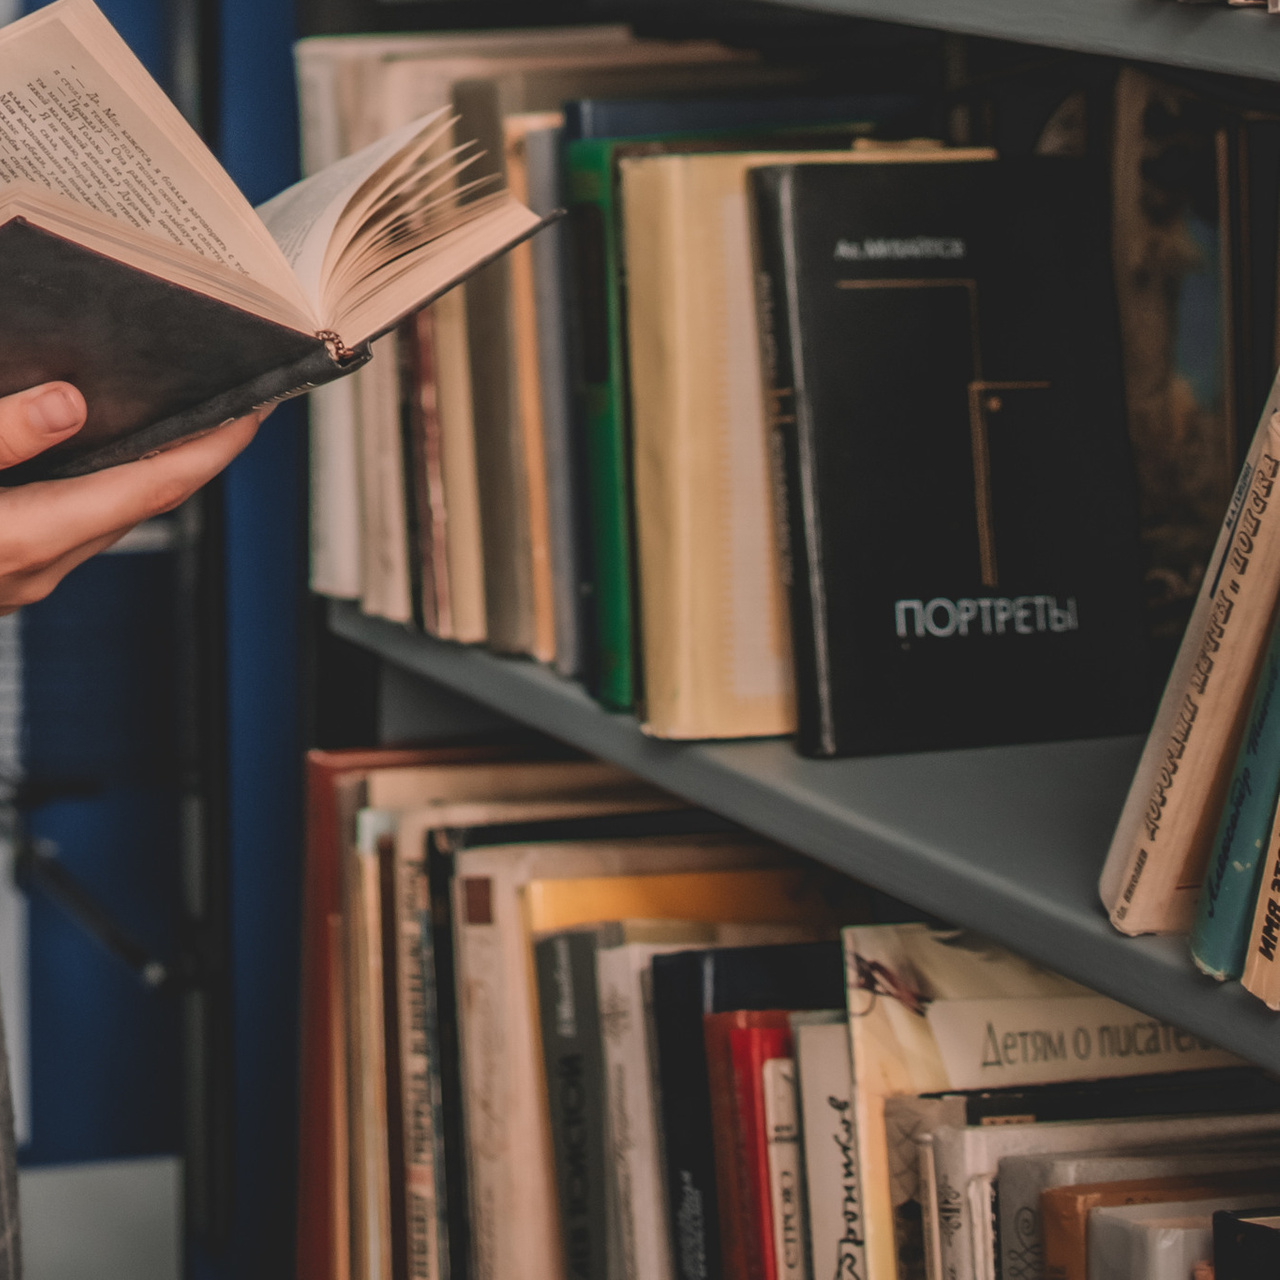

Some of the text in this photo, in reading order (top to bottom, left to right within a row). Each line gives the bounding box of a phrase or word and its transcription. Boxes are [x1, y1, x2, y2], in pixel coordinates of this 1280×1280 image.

[6, 90, 38, 123] владела
[60, 155, 94, 189] которая
[91, 190, 119, 218] теперь
[15, 116, 68, 175] воспоминания
[25, 80, 51, 105] такой
[46, 105, 89, 150] маленькой
[83, 149, 121, 188] девочки?
[60, 76, 83, 100] стоял
[89, 109, 120, 142] темноте
[117, 143, 135, 159] под
[133, 160, 159, 186] твоим
[156, 187, 184, 215] окном,
[66, 98, 207, 257] Правда? Она радостно улыбнулась
[75, 122, 108, 155] Только
[121, 177, 159, 217] понимаю,
[157, 218, 185, 247] почему
[101, 107, 123, 128] Мне
[119, 129, 154, 166] кажется,
[160, 175, 189, 204] боялся
[186, 206, 229, 252] заговорить
[894, 595, 1079, 637] ПОРТРЕТЫ
[1144, 694, 1198, 842] ДОРОГАМИ
[1191, 589, 1234, 695] МЕЧТЫ
[1230, 454, 1280, 575] ПОИСКА
[981, 1020, 1068, 1068] Детям
[1073, 1027, 1091, 1061] о
